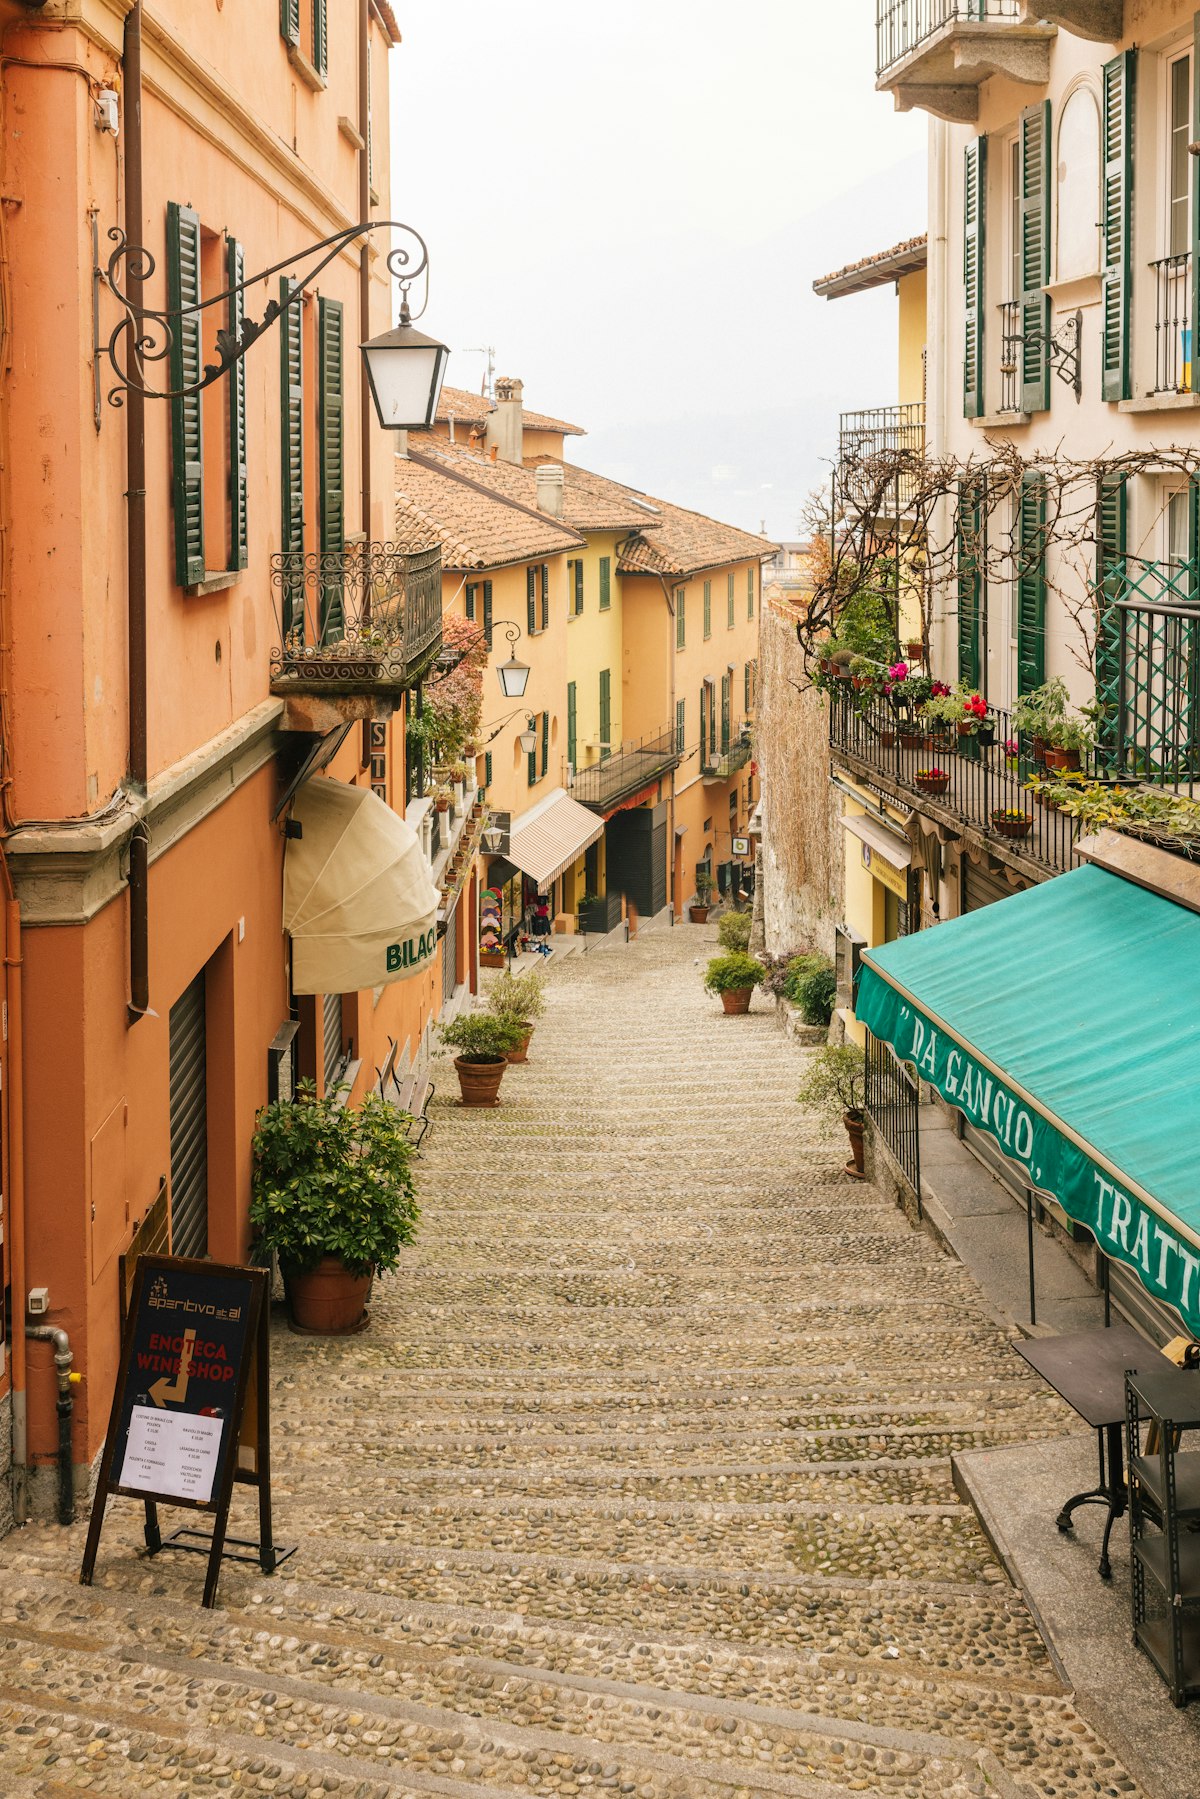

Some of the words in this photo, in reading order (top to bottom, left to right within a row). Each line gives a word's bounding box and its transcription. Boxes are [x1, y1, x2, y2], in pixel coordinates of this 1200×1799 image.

[1094, 1170, 1200, 1315] TRATT
[148, 1297, 216, 1315] aperitivo
[228, 1306, 241, 1319] al
[149, 1333, 227, 1360] ENOTECA
[137, 1352, 182, 1375] WINE
[186, 1360, 234, 1382] SHOP
